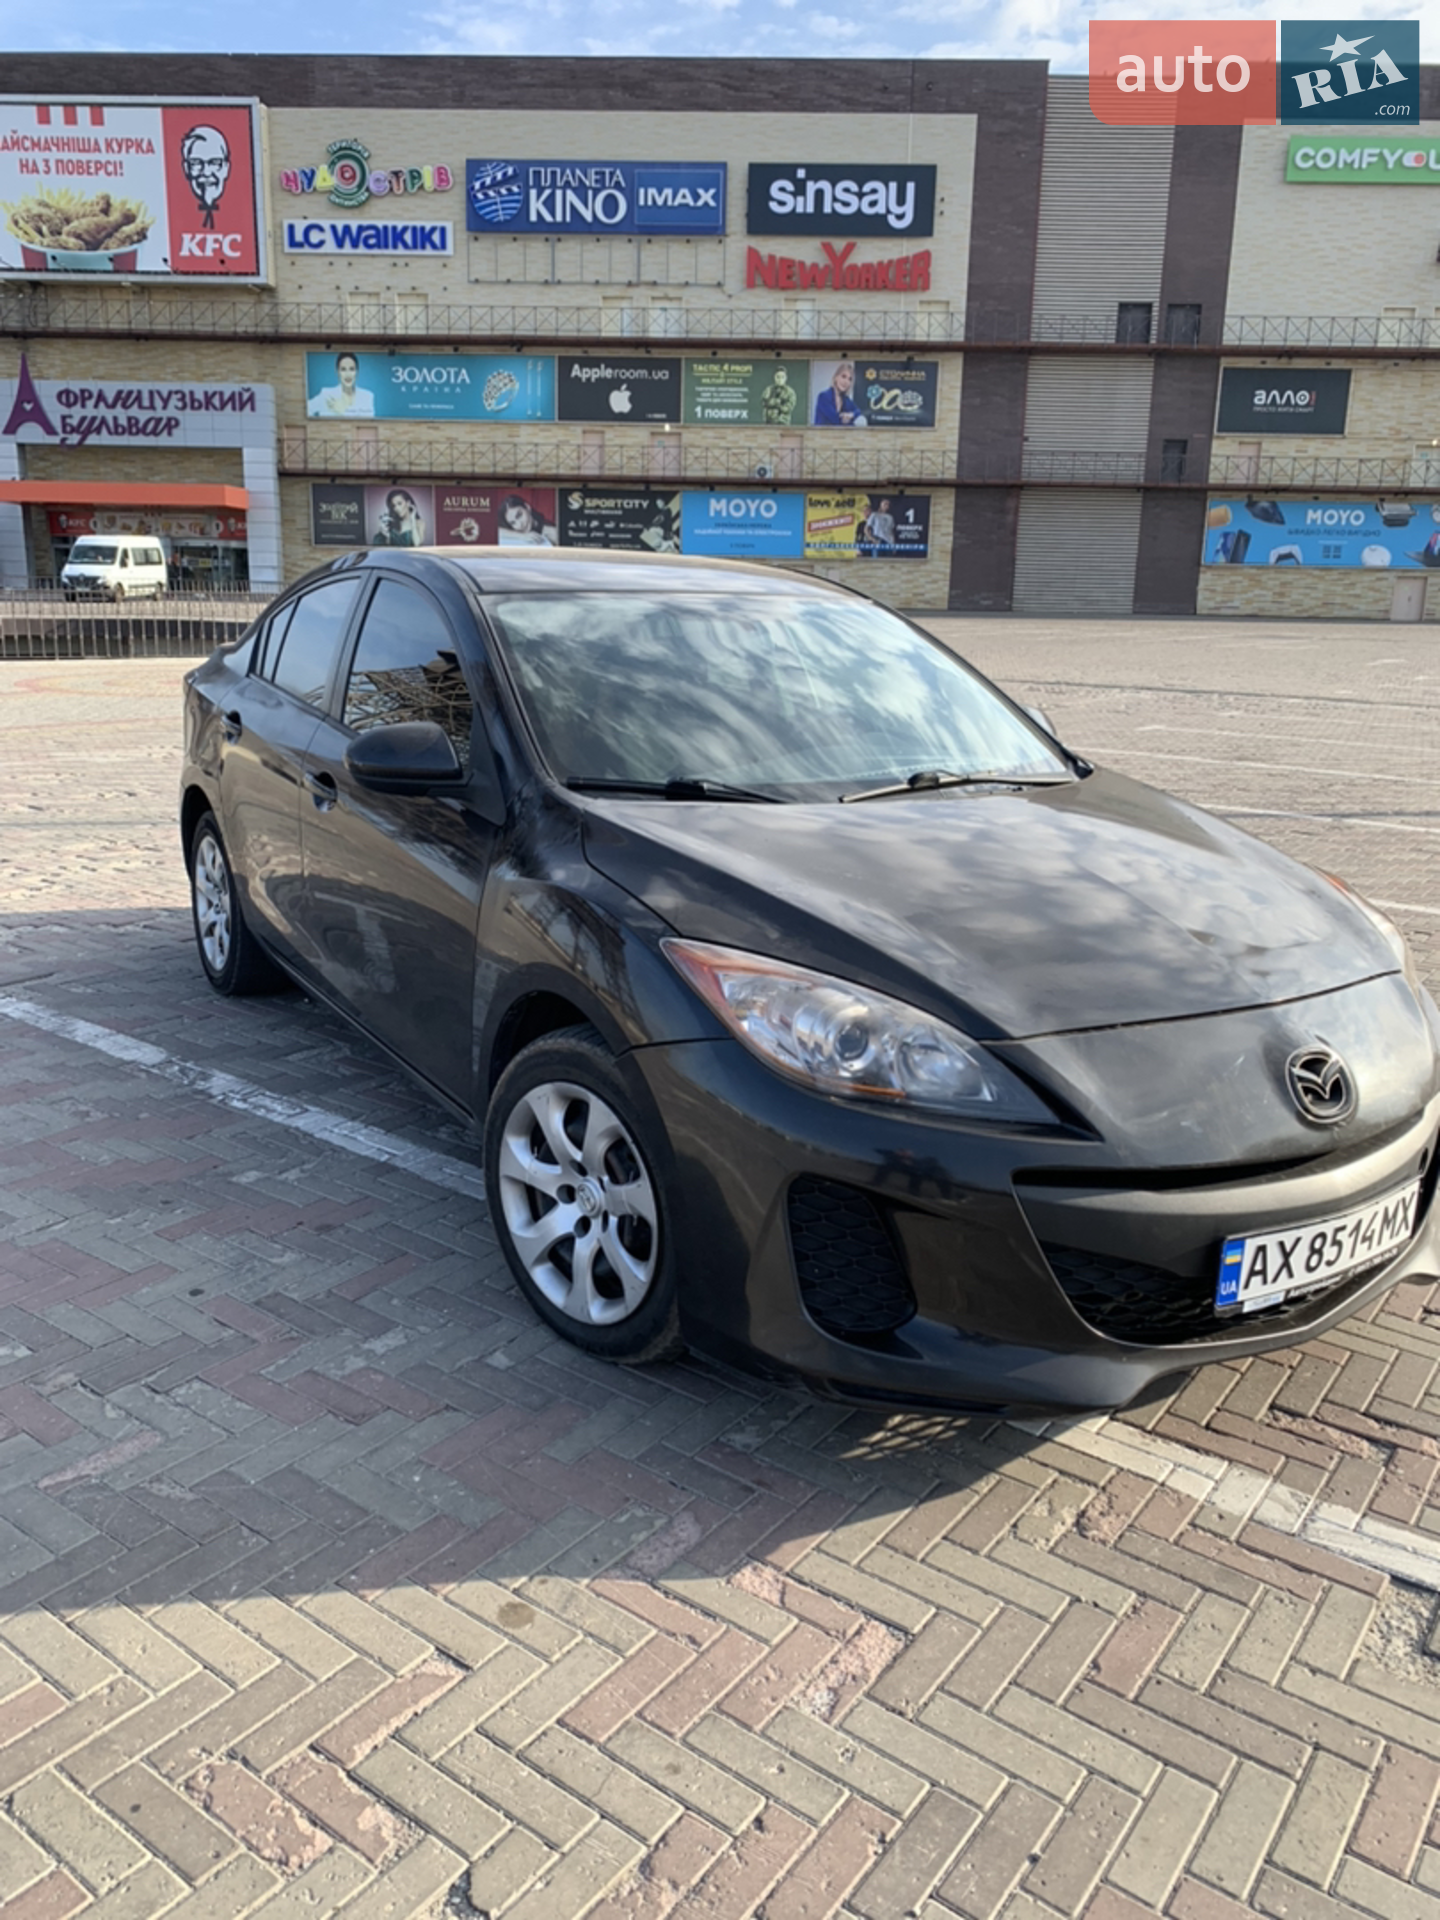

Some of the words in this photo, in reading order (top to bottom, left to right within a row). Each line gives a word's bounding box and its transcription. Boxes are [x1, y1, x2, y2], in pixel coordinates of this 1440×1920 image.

[104, 137, 155, 154] КУРКА
[1294, 146, 1403, 169] COMFY
[19, 158, 39, 174] НА
[42, 159, 51, 175] 3
[55, 159, 124, 177] ПОВЕРСІ!
[638, 187, 717, 207] IMAX
[768, 168, 916, 229] sinsay
[179, 233, 242, 257] KFC
[287, 223, 326, 249] LC
[391, 366, 471, 384] ЗОЛОТА
[571, 364, 669, 382] Appleroom.ua
[56, 388, 256, 412] ФРАНЦУЗЬКИЙ
[694, 405, 702, 419] 1
[704, 408, 749, 419] ПОВЕРХ
[443, 496, 491, 508] AURUM
[708, 497, 778, 519] MOYO
[905, 508, 915, 524] 1
[1306, 509, 1366, 526] MOYO
[1220, 1282, 1237, 1296] UA
